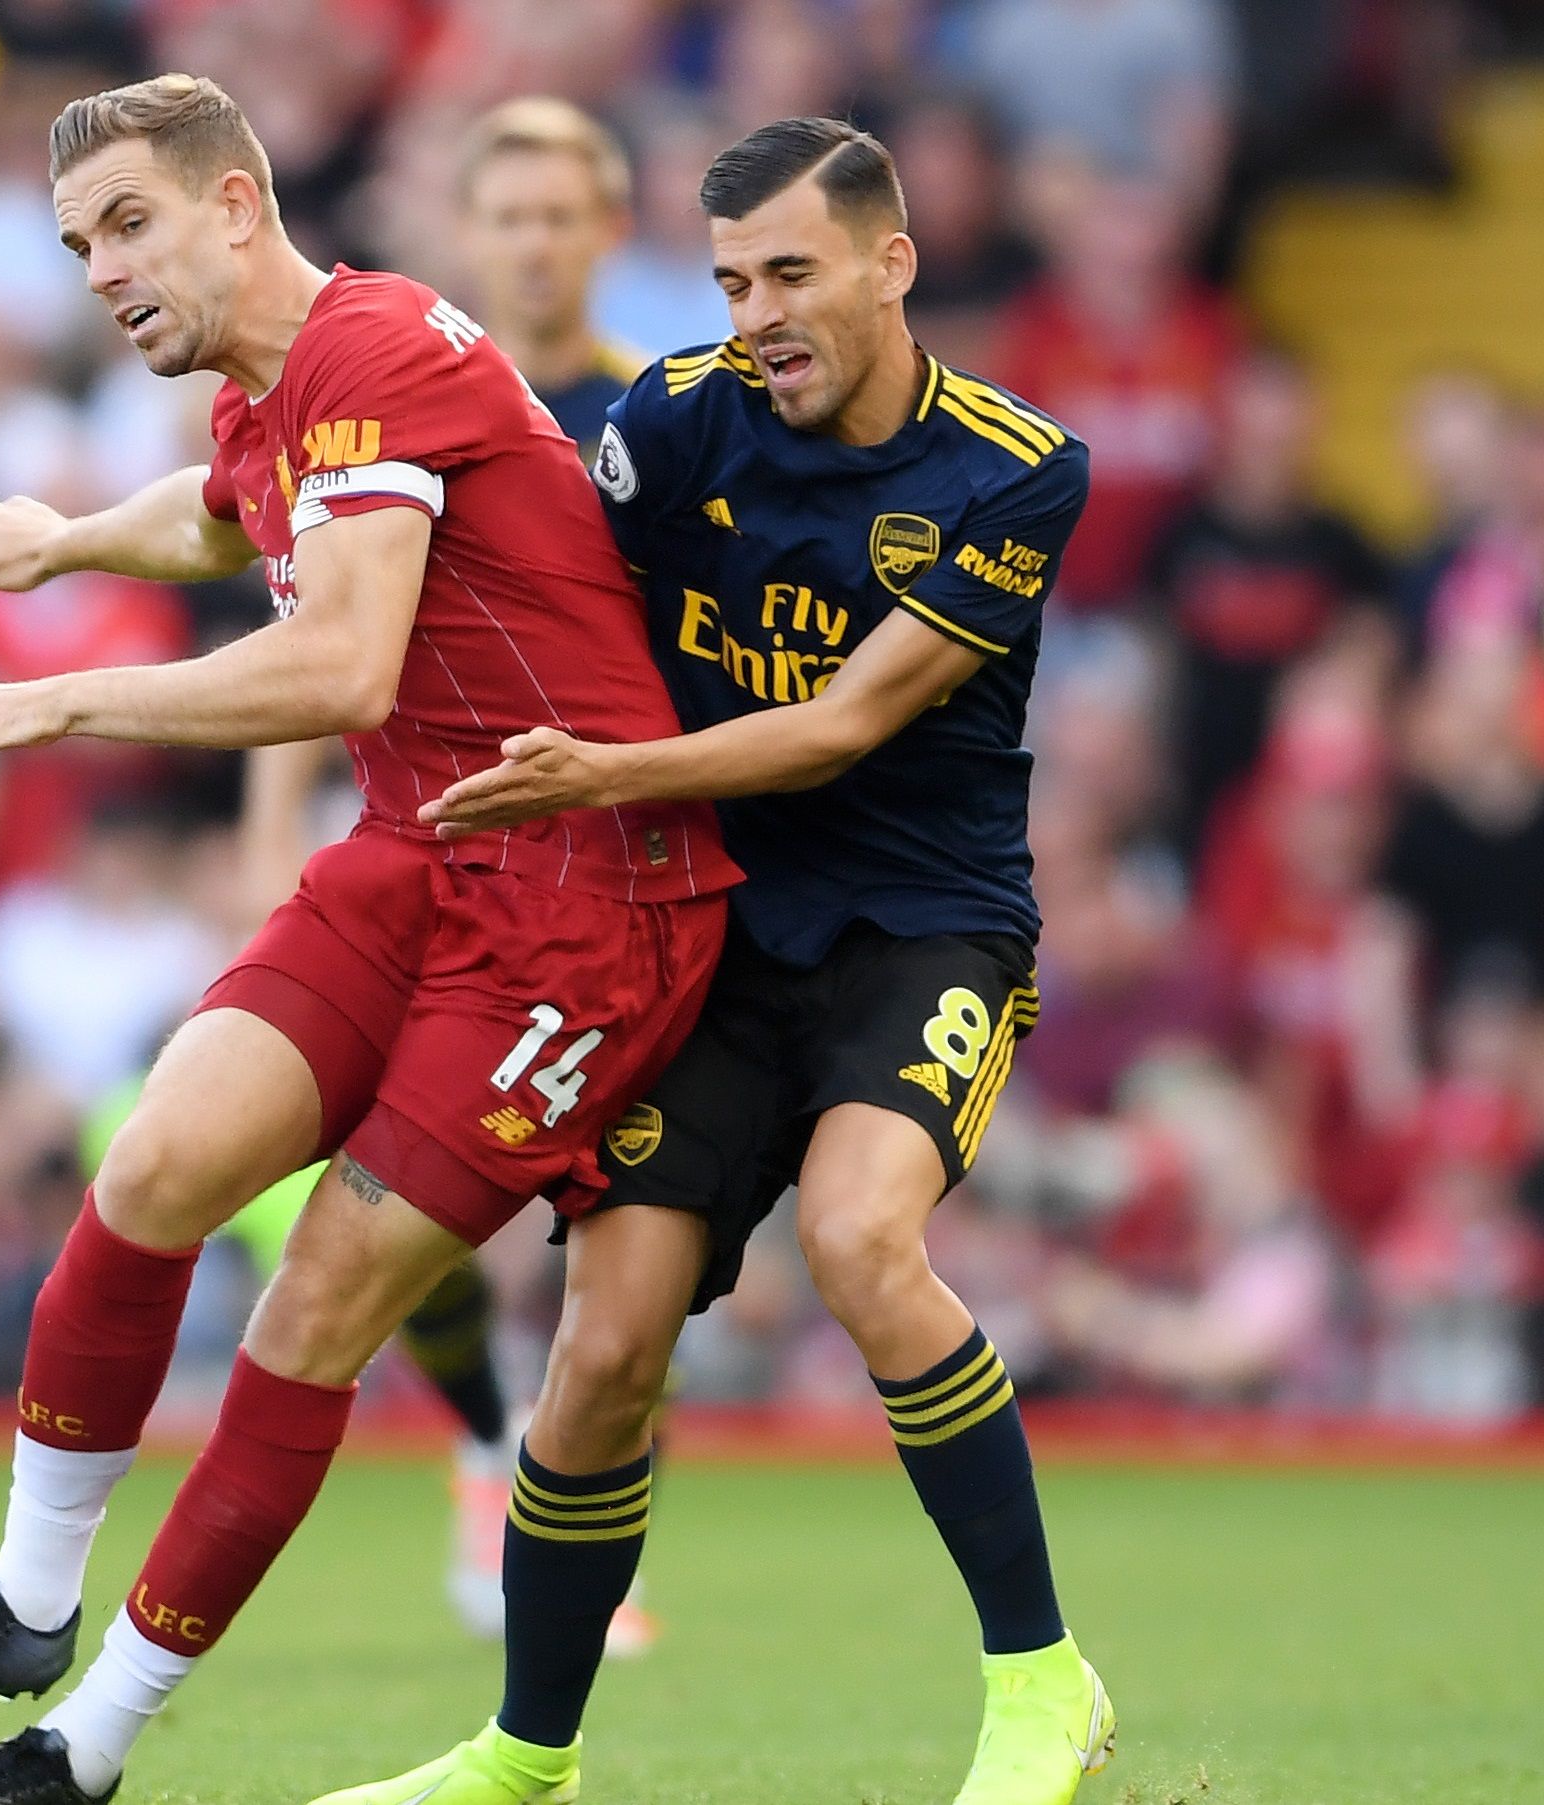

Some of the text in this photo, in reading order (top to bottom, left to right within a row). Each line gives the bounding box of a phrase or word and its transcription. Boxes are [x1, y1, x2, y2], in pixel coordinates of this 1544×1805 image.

[302, 418, 382, 468] WU
[678, 587, 847, 703] Emira
[761, 583, 849, 647] Fly
[490, 1003, 605, 1128] 14
[922, 986, 991, 1079] 8
